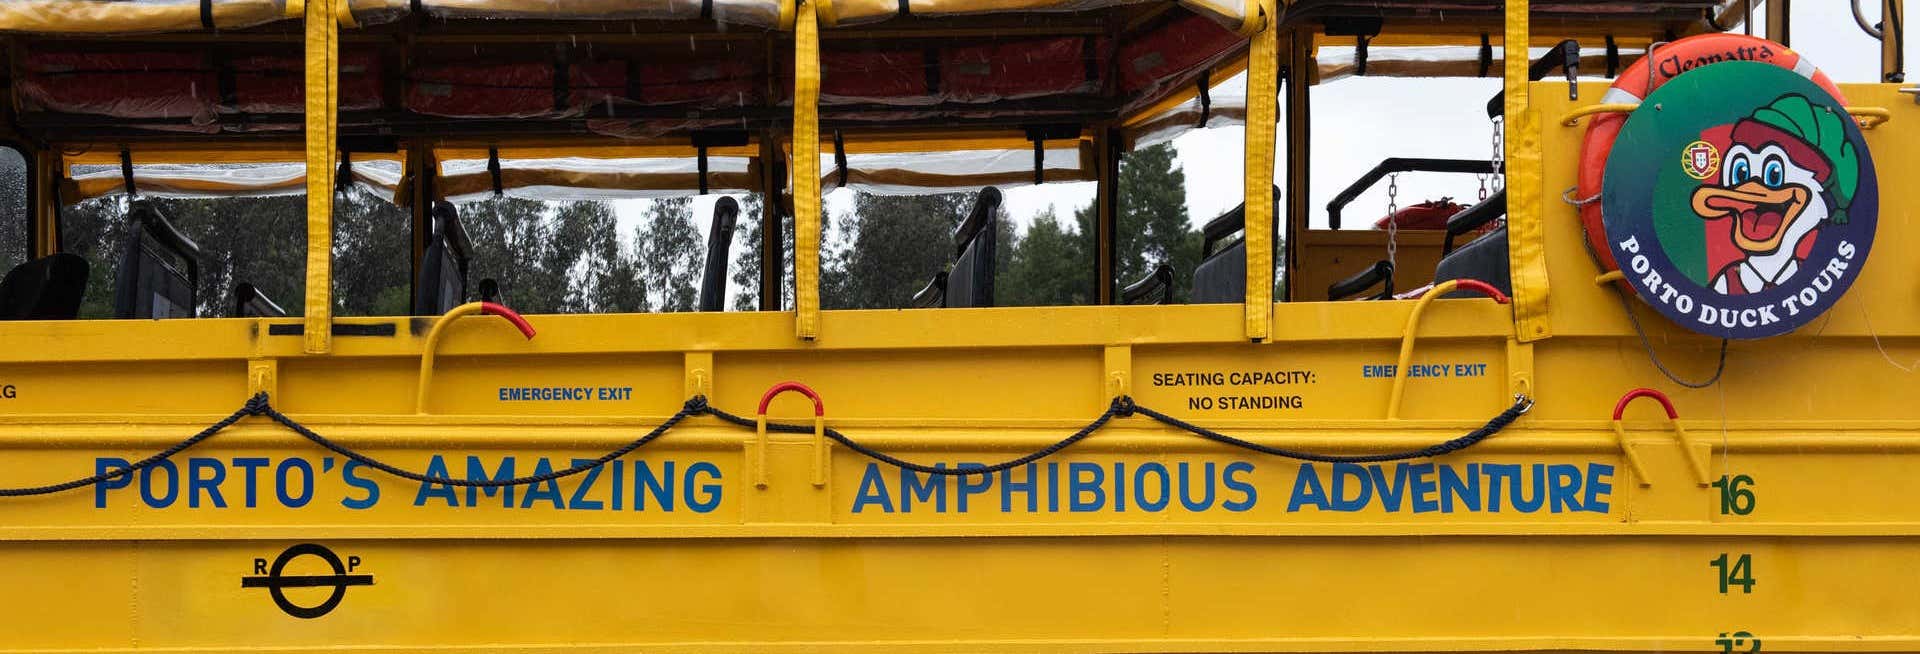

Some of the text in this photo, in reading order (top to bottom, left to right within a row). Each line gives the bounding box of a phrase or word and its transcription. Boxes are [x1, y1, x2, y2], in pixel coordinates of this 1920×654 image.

[1620, 235, 1856, 328] PORTO DUCK TOURS
[1153, 371, 1317, 387] SEATING CAPACITY:
[1455, 364, 1487, 376] EXIT
[0, 384, 16, 399] G
[499, 388, 633, 400] EMERGENCY EXIT
[1188, 396, 1303, 410] NO STANDING
[414, 455, 723, 512] AMAZING
[852, 462, 1257, 514] AMPHIBIOUS
[1287, 460, 1615, 514] ADVENTURE
[1711, 474, 1756, 516] 16
[254, 555, 361, 576] R P
[1710, 553, 1756, 594] 14
